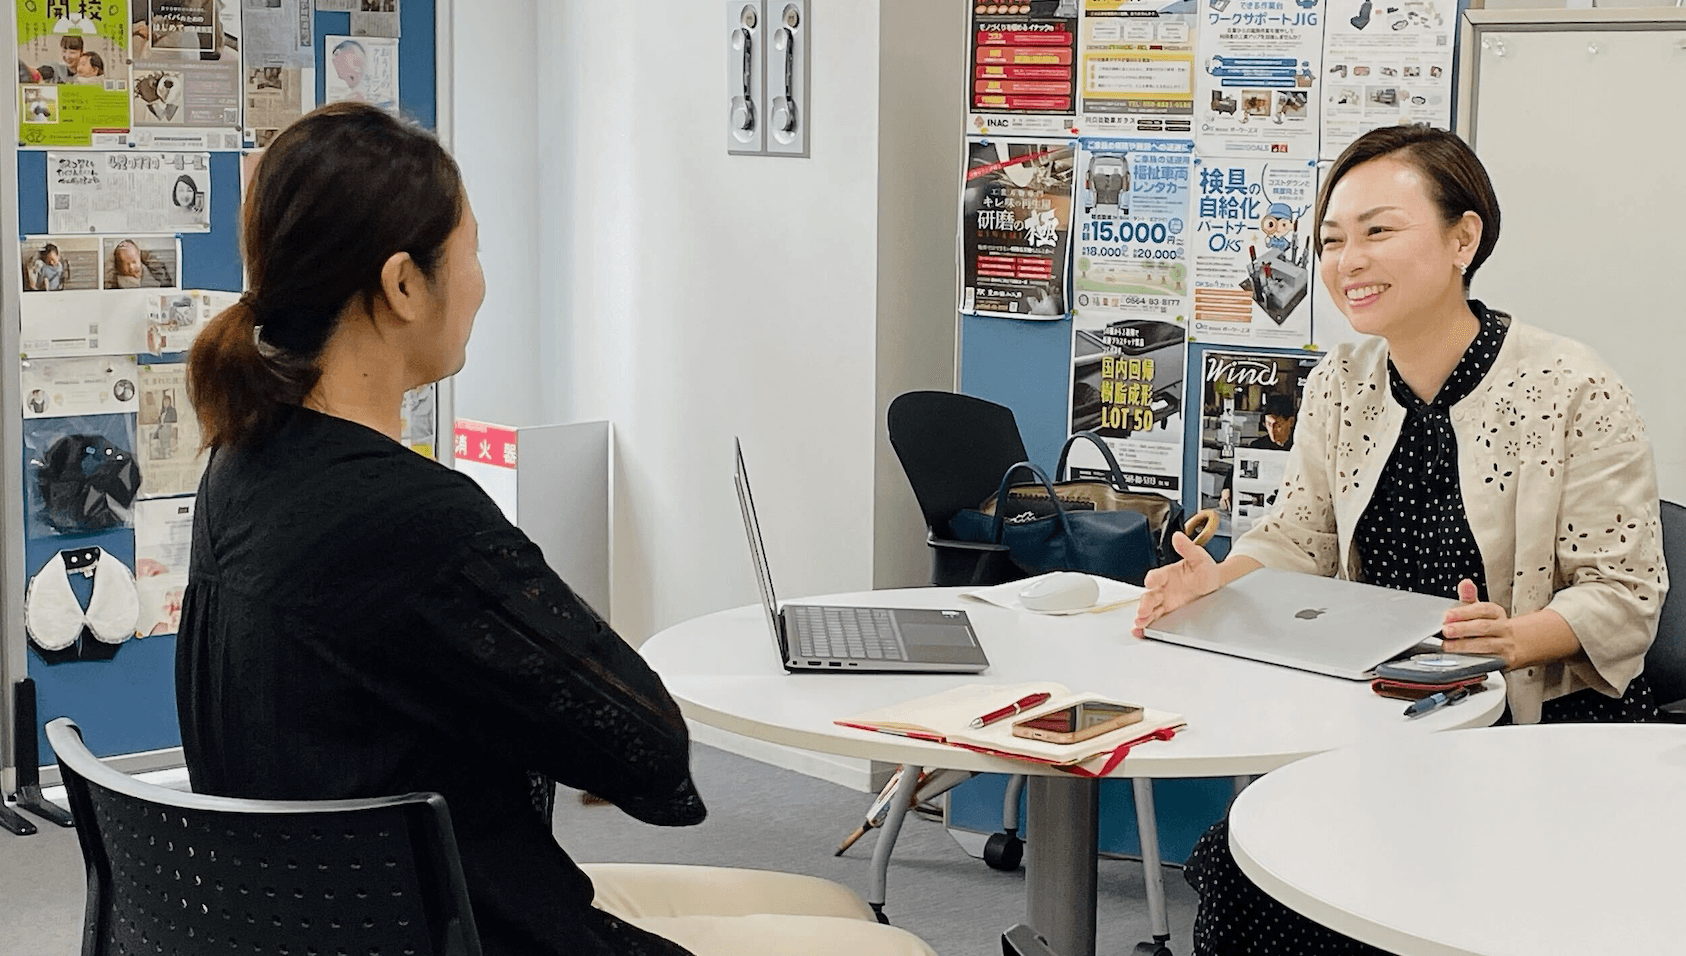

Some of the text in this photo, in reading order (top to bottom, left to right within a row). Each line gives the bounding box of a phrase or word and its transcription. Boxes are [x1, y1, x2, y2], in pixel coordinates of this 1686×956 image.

[1209, 12, 1317, 26] ワークサポートJIG
[987, 119, 1009, 127] INAC
[1133, 165, 1188, 181] 福祉車両
[1199, 167, 1261, 195] 検具の
[1133, 181, 1187, 194] レンタカー
[1199, 195, 1260, 220] 自給化
[1091, 221, 1166, 244] 15,000
[1197, 220, 1259, 235] パートナー
[1209, 233, 1243, 252] OKS
[1101, 357, 1155, 381] 国内回帰
[1206, 357, 1279, 387] Wind
[1101, 380, 1153, 407] 樹脂成形
[1101, 406, 1154, 432] LOT 50
[455, 434, 517, 464] 消火器
